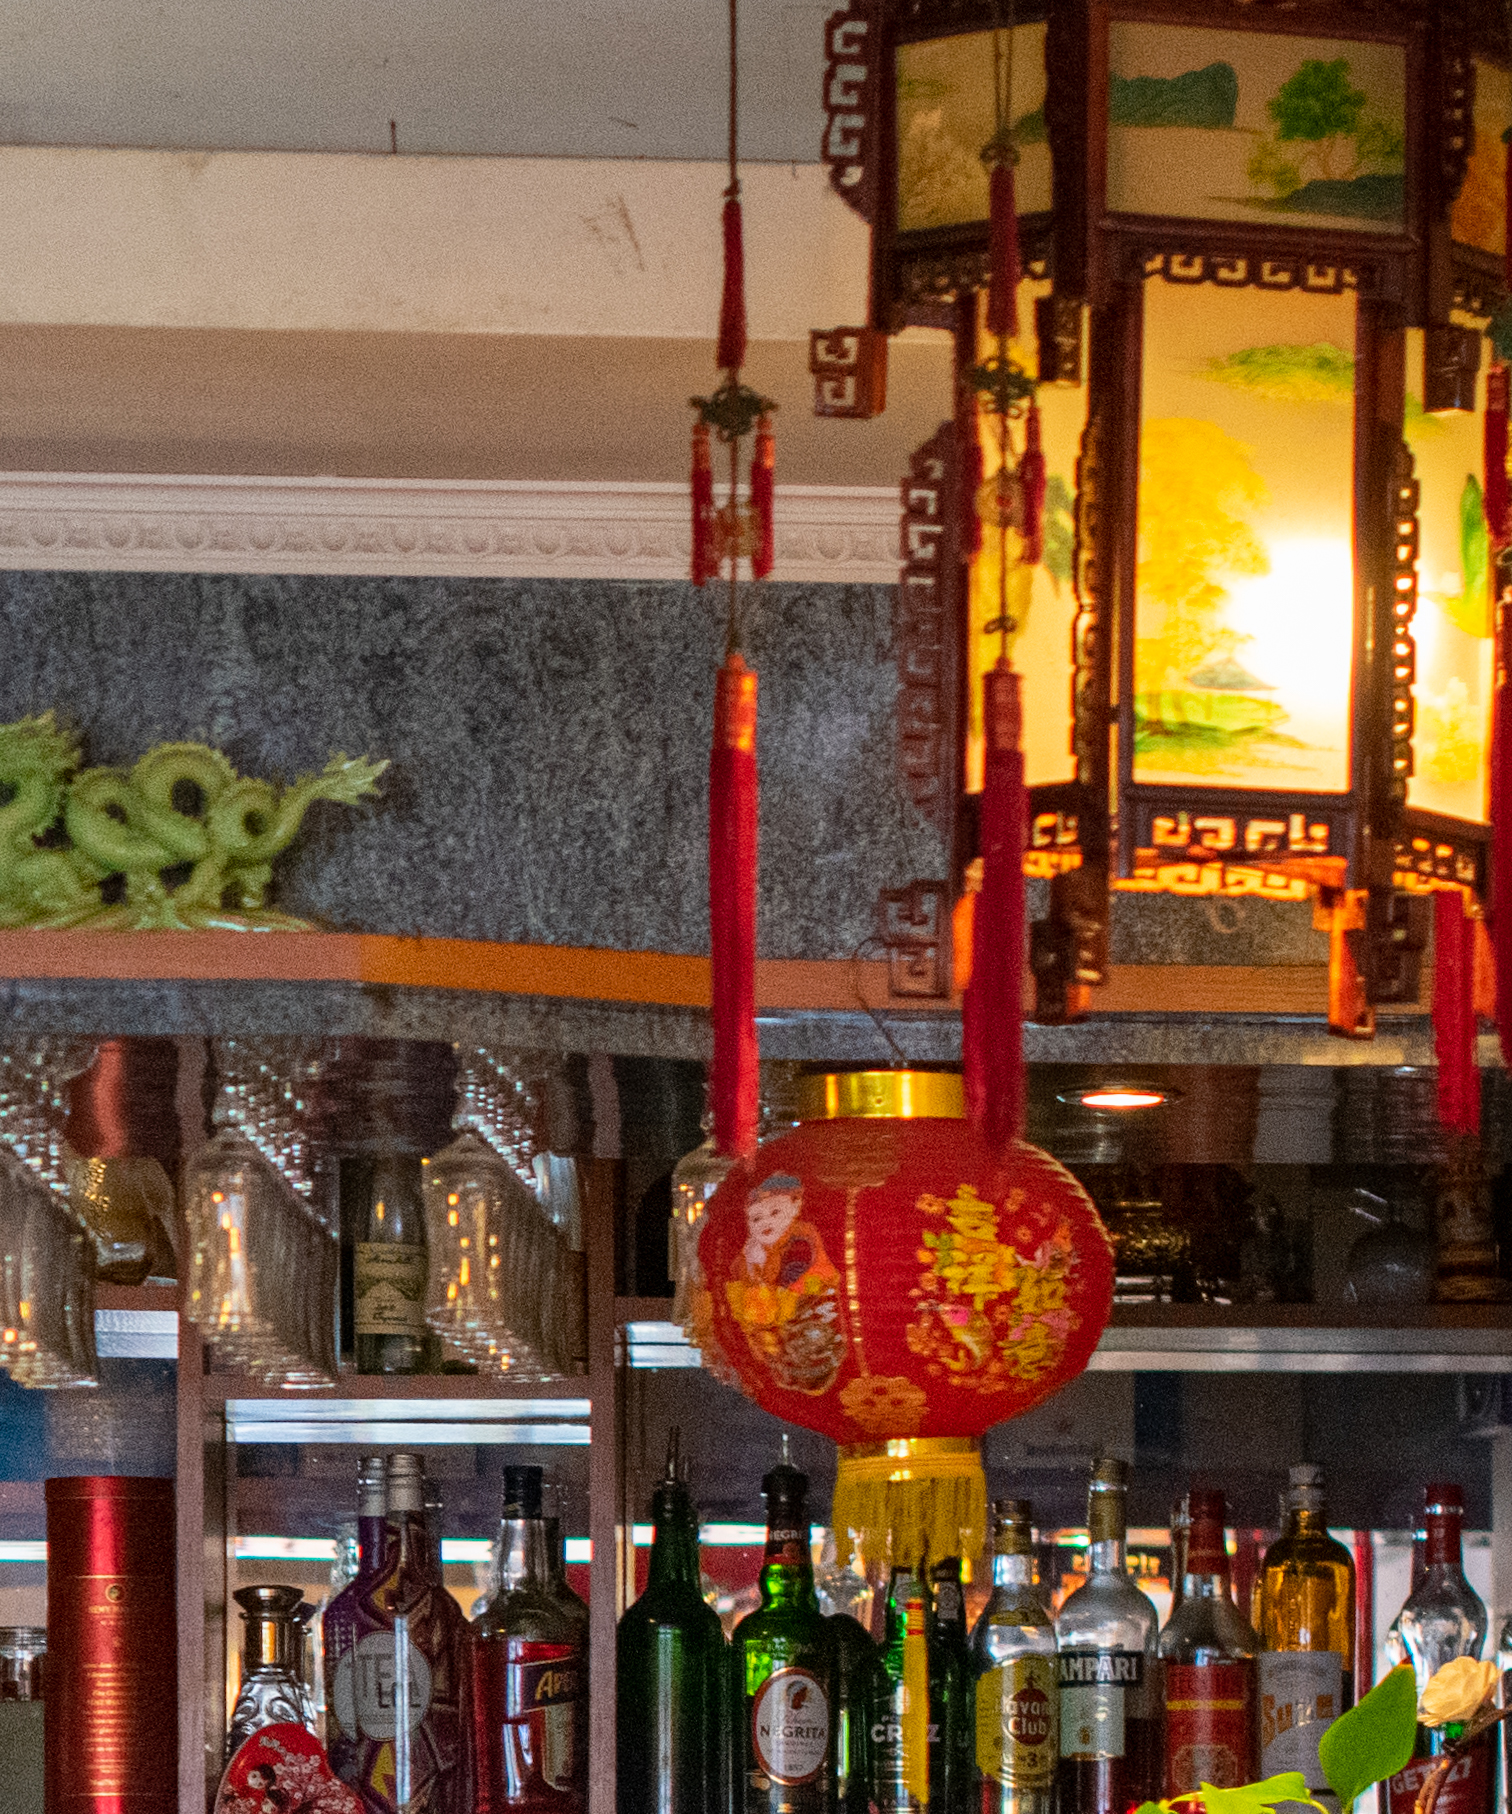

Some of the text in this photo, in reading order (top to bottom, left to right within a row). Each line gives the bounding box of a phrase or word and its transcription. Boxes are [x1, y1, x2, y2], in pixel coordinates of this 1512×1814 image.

[1061, 1656, 1137, 1681] AMPARI
[760, 1725, 826, 1739] NEGRITA
[870, 1723, 941, 1743] CRZ
